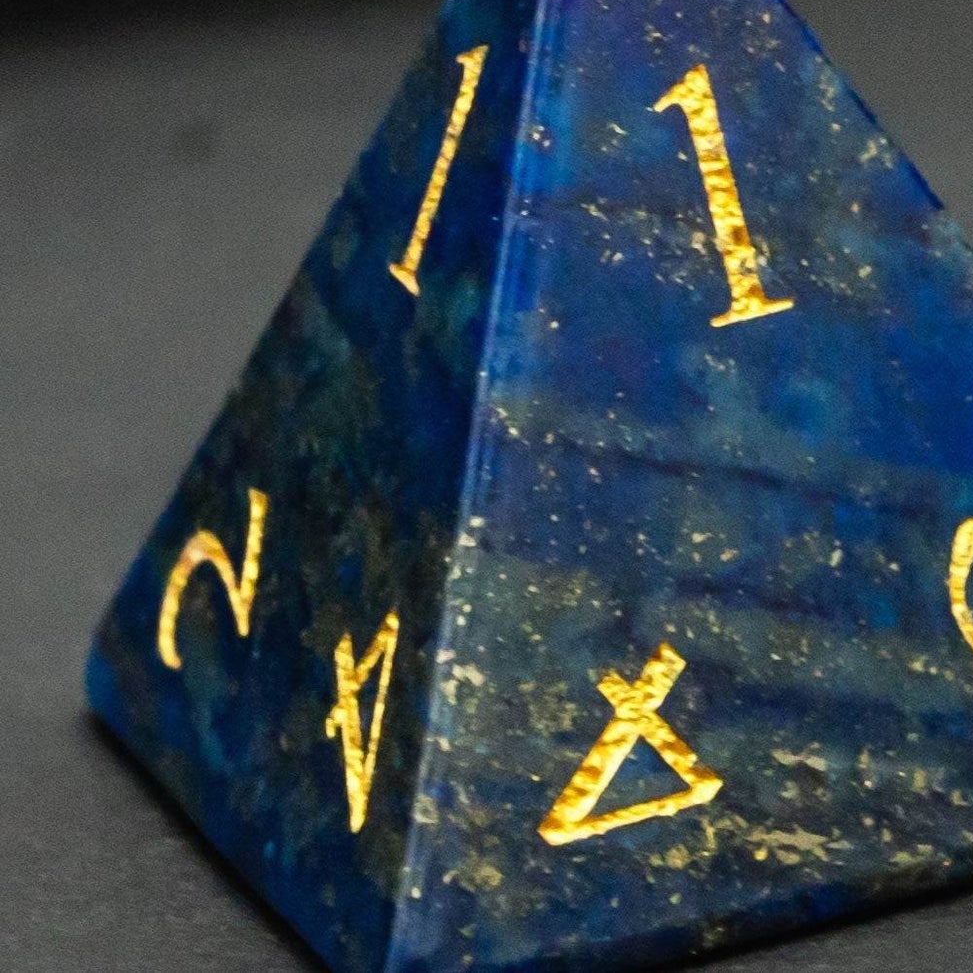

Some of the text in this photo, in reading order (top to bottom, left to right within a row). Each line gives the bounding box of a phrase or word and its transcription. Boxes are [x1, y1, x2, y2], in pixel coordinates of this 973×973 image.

[390, 45, 488, 295] 1
[652, 64, 793, 327] 1
[156, 488, 268, 668] 2
[324, 610, 400, 833] 4
[537, 641, 724, 844] 4
